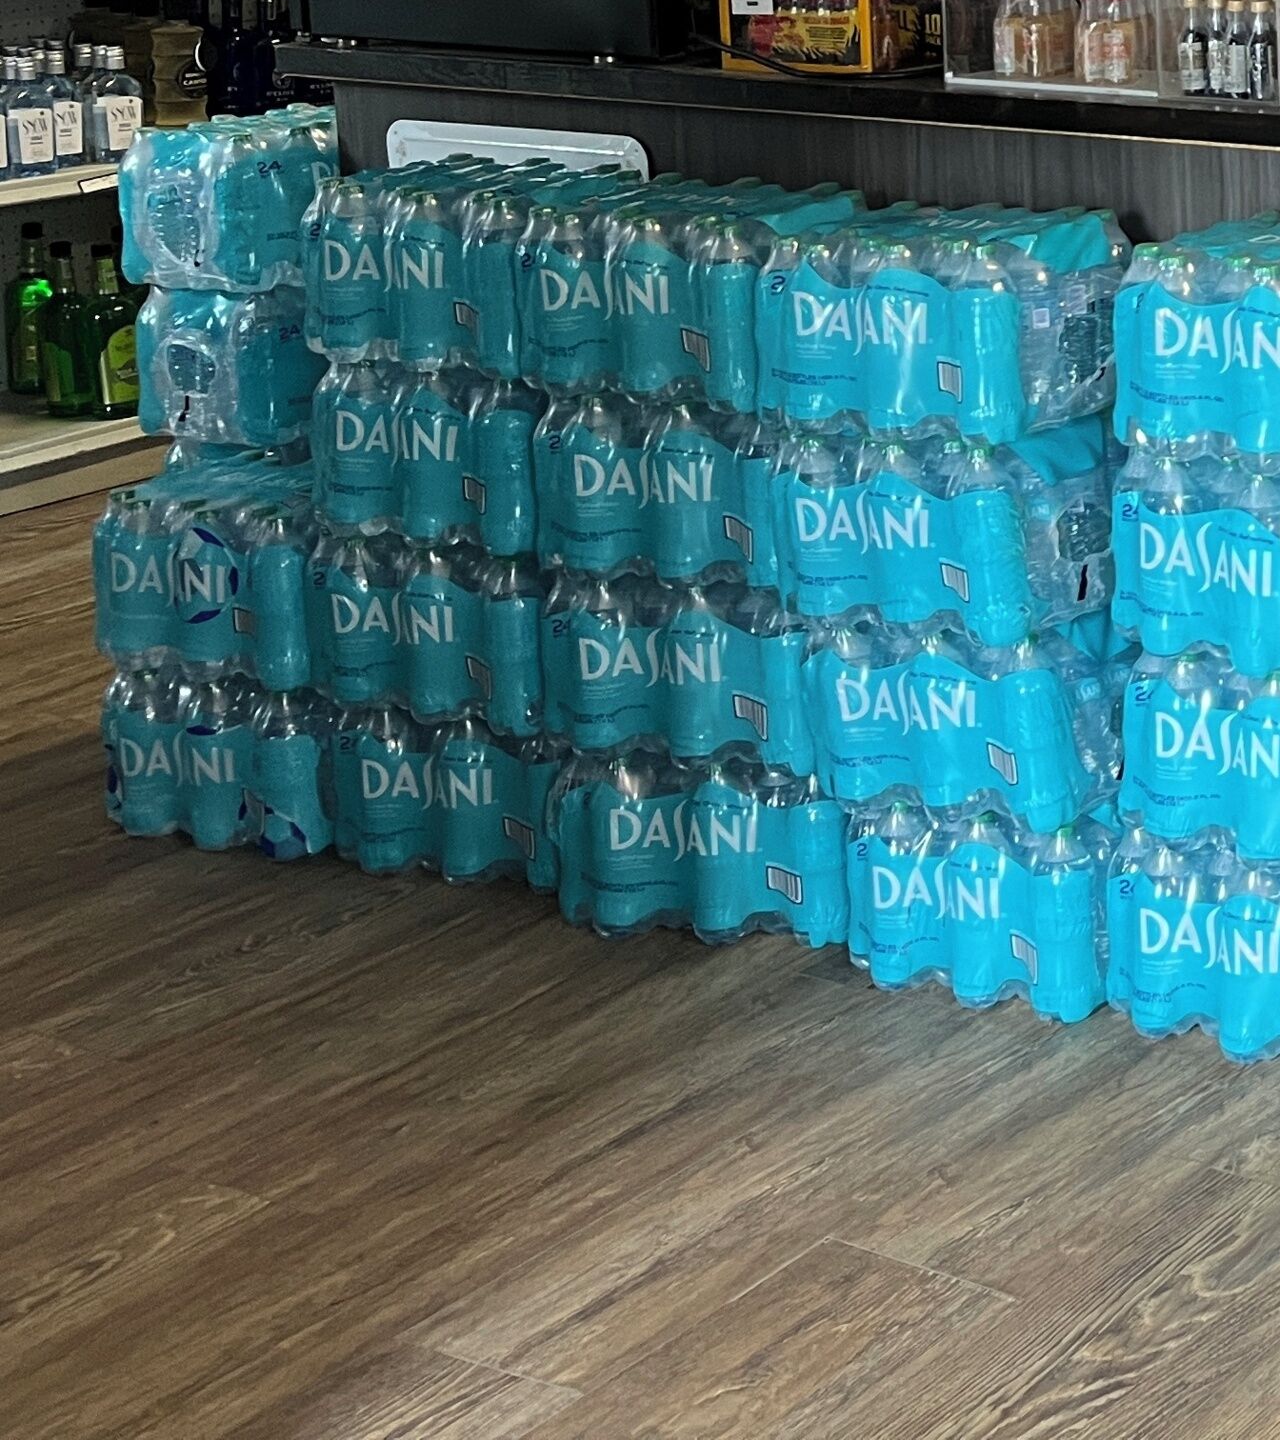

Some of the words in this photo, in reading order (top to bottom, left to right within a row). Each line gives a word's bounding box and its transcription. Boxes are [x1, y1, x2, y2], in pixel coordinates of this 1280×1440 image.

[925, 13, 940, 34] 10
[258, 161, 282, 176] 24
[792, 288, 927, 355] DASANI
[573, 446, 713, 509] DASANI
[796, 490, 930, 554] DASANI
[1139, 521, 1272, 597] DASANI
[579, 628, 722, 688] DASANI
[836, 668, 977, 736] DASANI
[610, 798, 758, 862] DASANI
[872, 851, 999, 920] DASANI
[1139, 902, 1280, 975] DASANI
